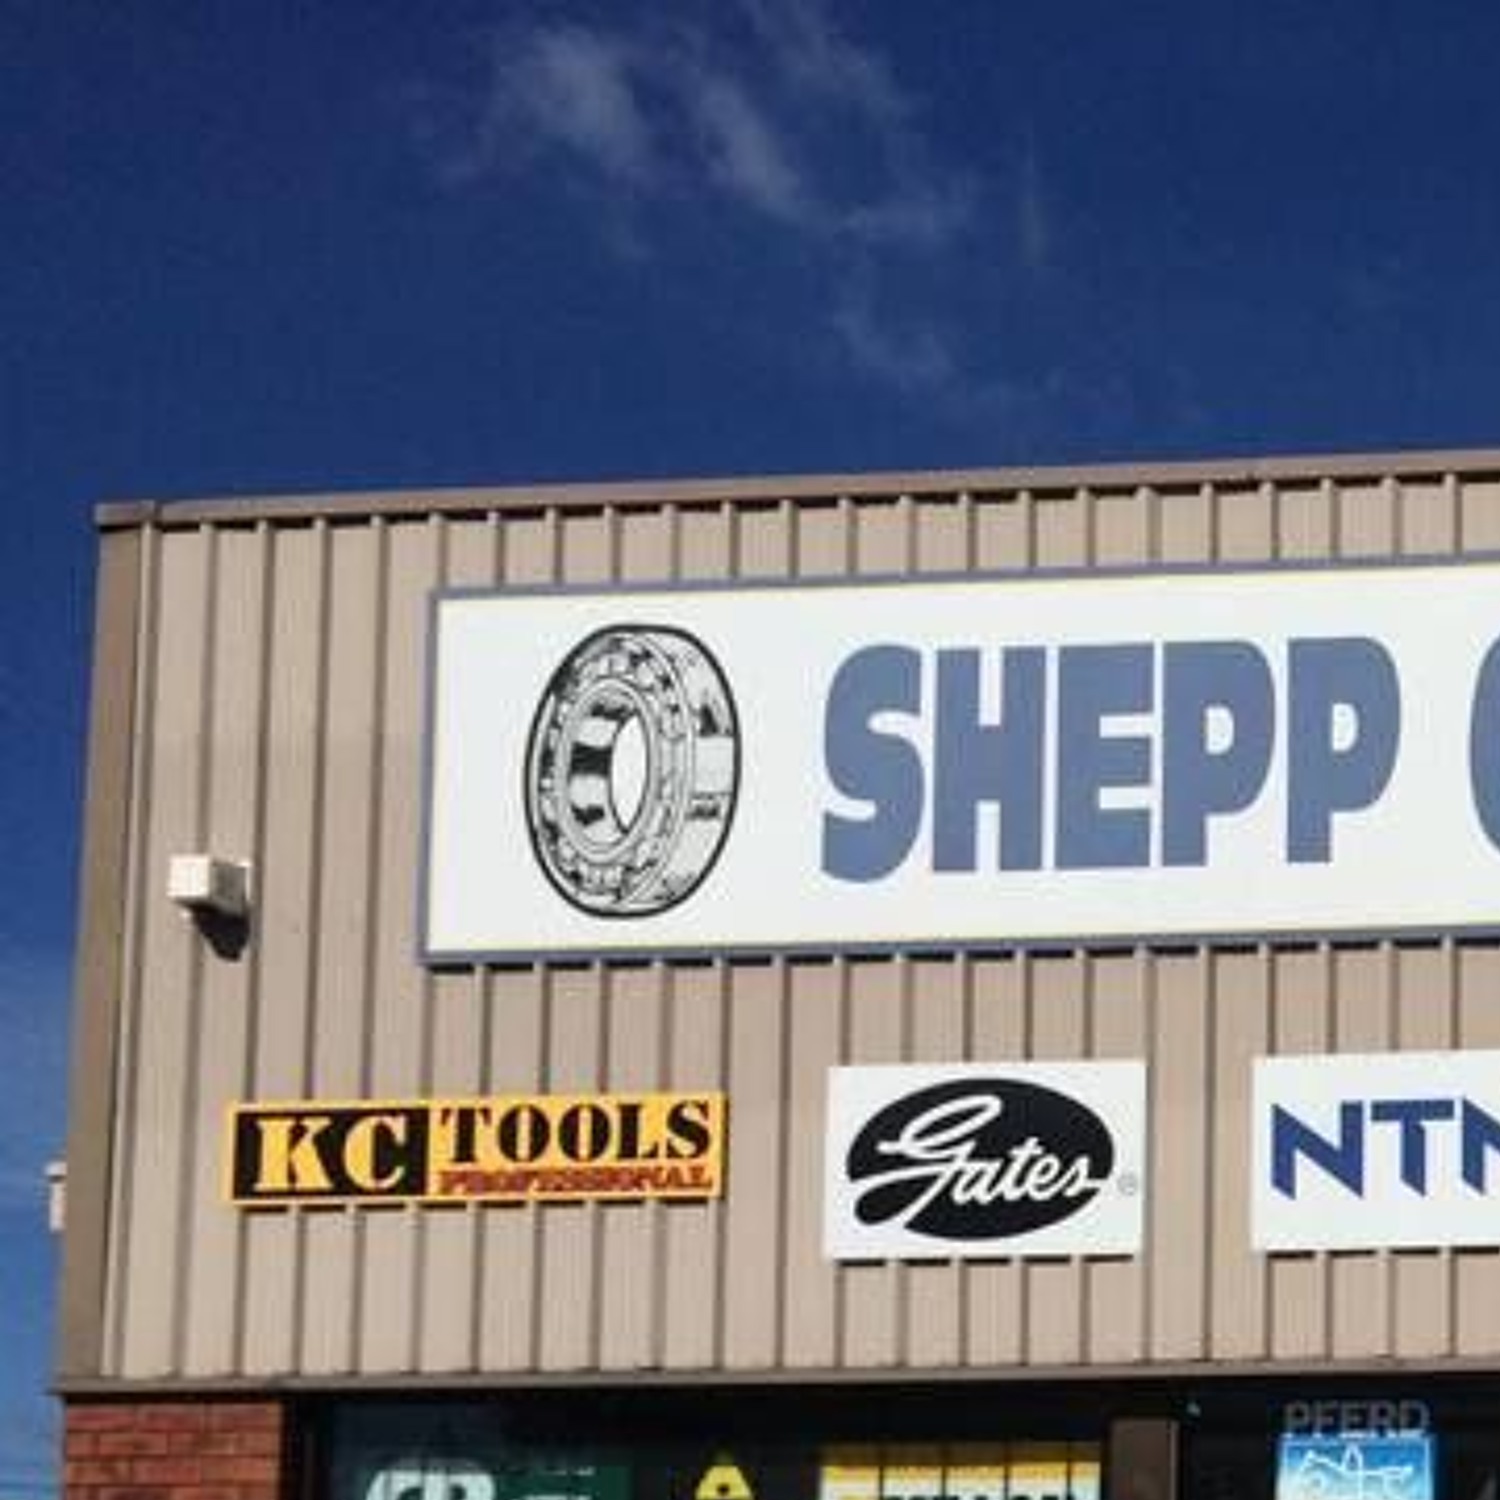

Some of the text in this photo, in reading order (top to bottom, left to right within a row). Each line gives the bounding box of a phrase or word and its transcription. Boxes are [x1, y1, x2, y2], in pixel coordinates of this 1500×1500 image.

[821, 635, 1401, 884] SHEPP
[252, 1099, 713, 1193] KC TOOLS
[437, 1164, 713, 1194] PROFESSIONAL
[850, 1094, 1104, 1228] Gates
[1284, 1400, 1431, 1436] PFERD
